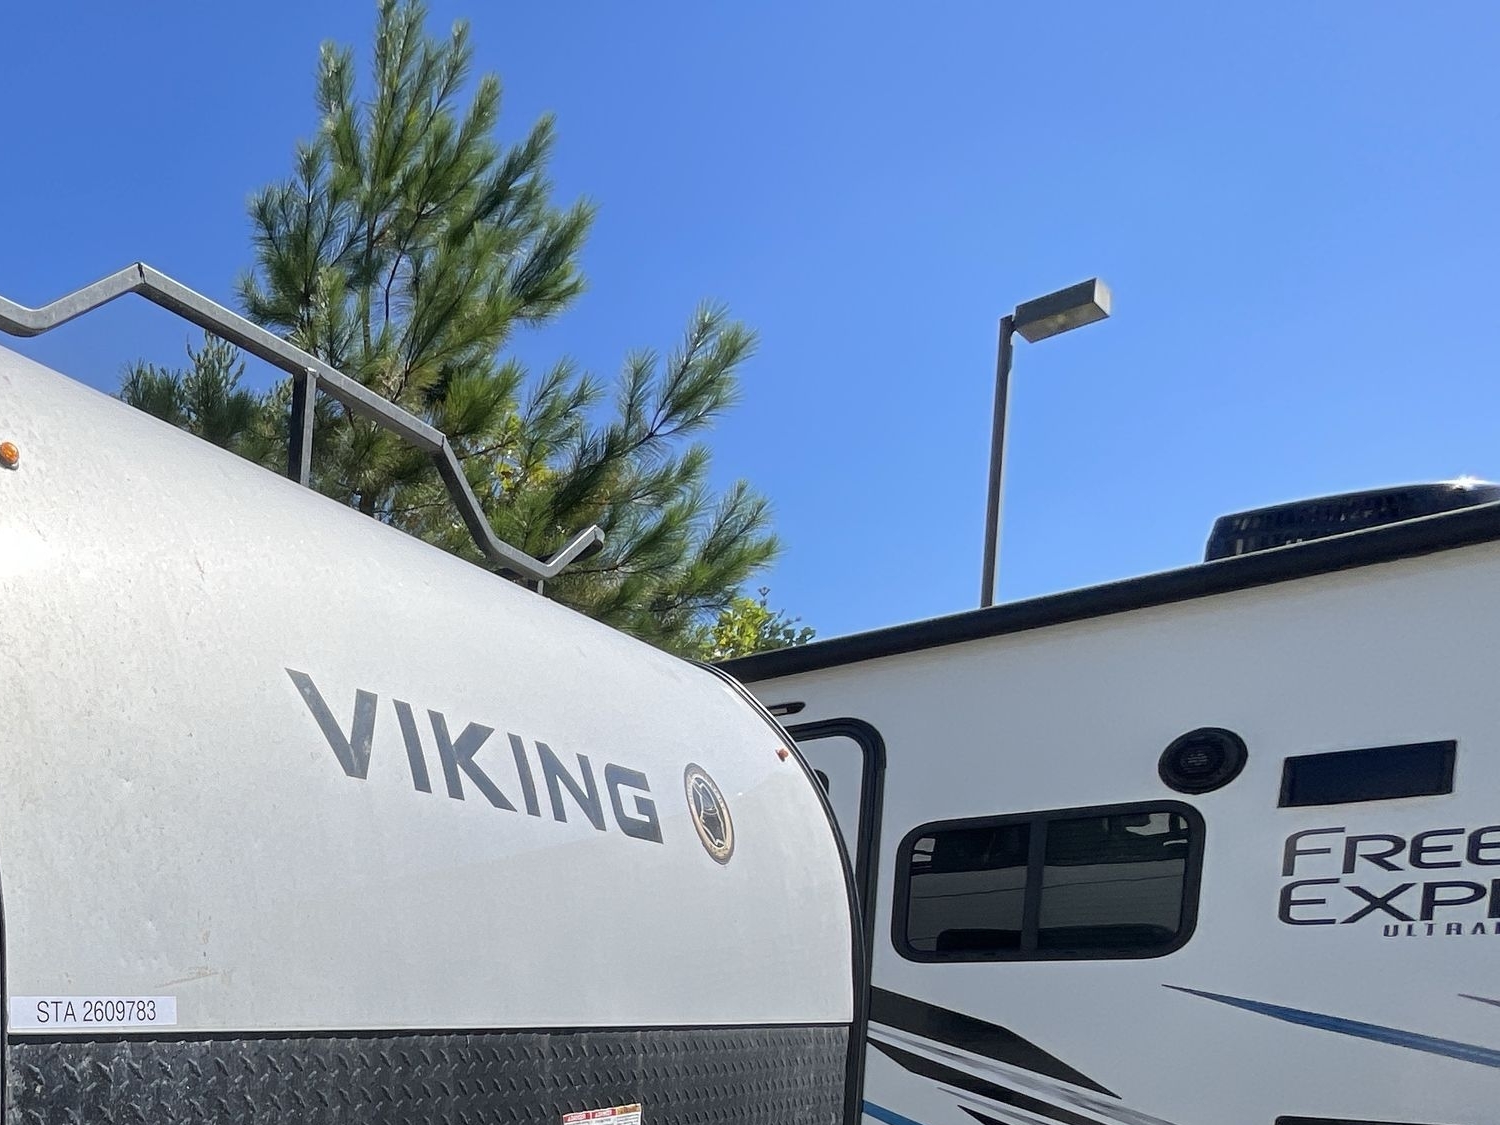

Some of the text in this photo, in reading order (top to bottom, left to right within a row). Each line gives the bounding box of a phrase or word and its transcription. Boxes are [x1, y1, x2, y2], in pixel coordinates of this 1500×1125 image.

[284, 667, 664, 845] VIKING
[36, 1000, 156, 1023] STA 2609783
